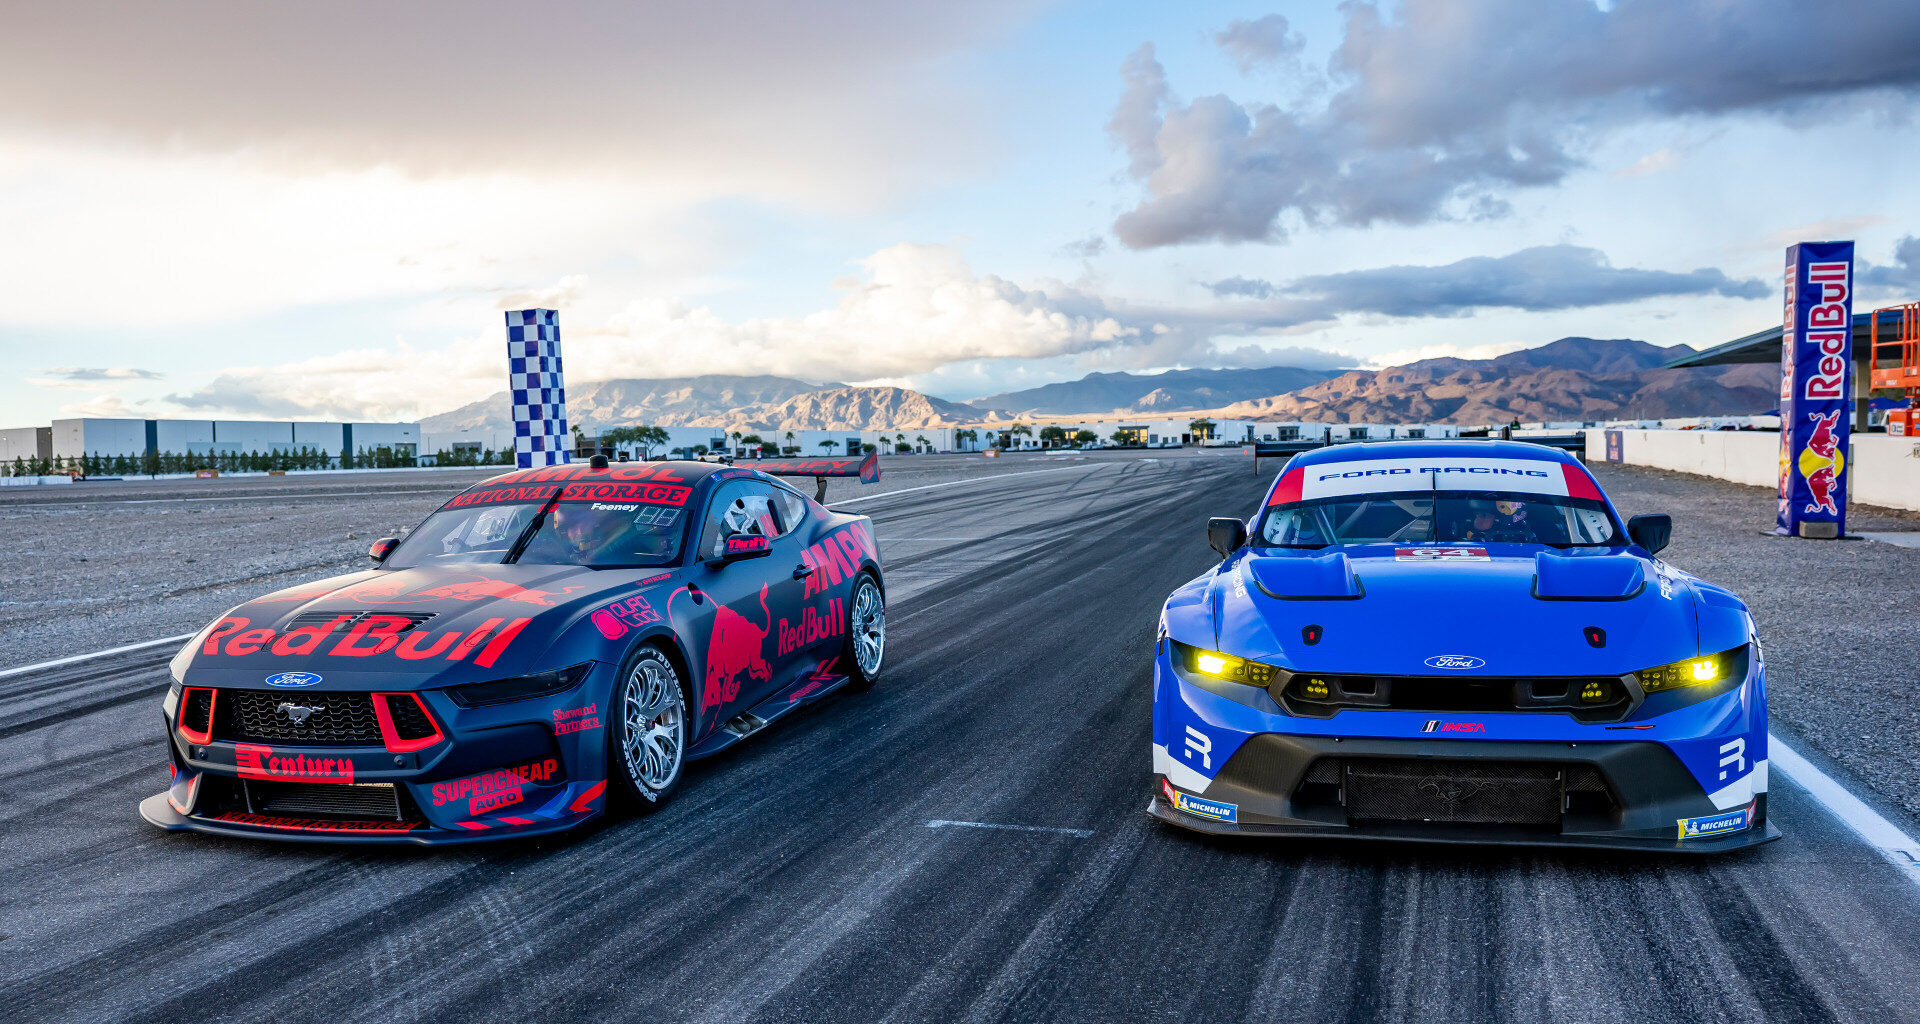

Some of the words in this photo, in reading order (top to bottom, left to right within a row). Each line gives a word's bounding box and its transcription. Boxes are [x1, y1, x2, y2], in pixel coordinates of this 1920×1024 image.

[484, 467, 684, 486] AMPOL
[1319, 468, 1411, 482] FORD
[1420, 467, 1549, 478] RACING
[444, 485, 559, 509] NATIONAL
[563, 485, 683, 502] STORAGE
[591, 503, 639, 513] Feeney
[728, 536, 770, 551] Thrifty
[800, 521, 878, 600] AMPOL
[1411, 548, 1475, 557] 64
[610, 595, 651, 618] QUAD
[622, 608, 665, 628] LOCK
[1435, 656, 1475, 667] Ford
[272, 673, 314, 685] Ford
[554, 717, 601, 735] Partners
[1441, 722, 1486, 733] IMSA
[235, 743, 354, 784] Century
[432, 758, 558, 807] SUPERCHEAP
[475, 792, 517, 811] AUTO
[1189, 801, 1231, 816] MICHELIN
[1700, 817, 1742, 831] MICHELIN
